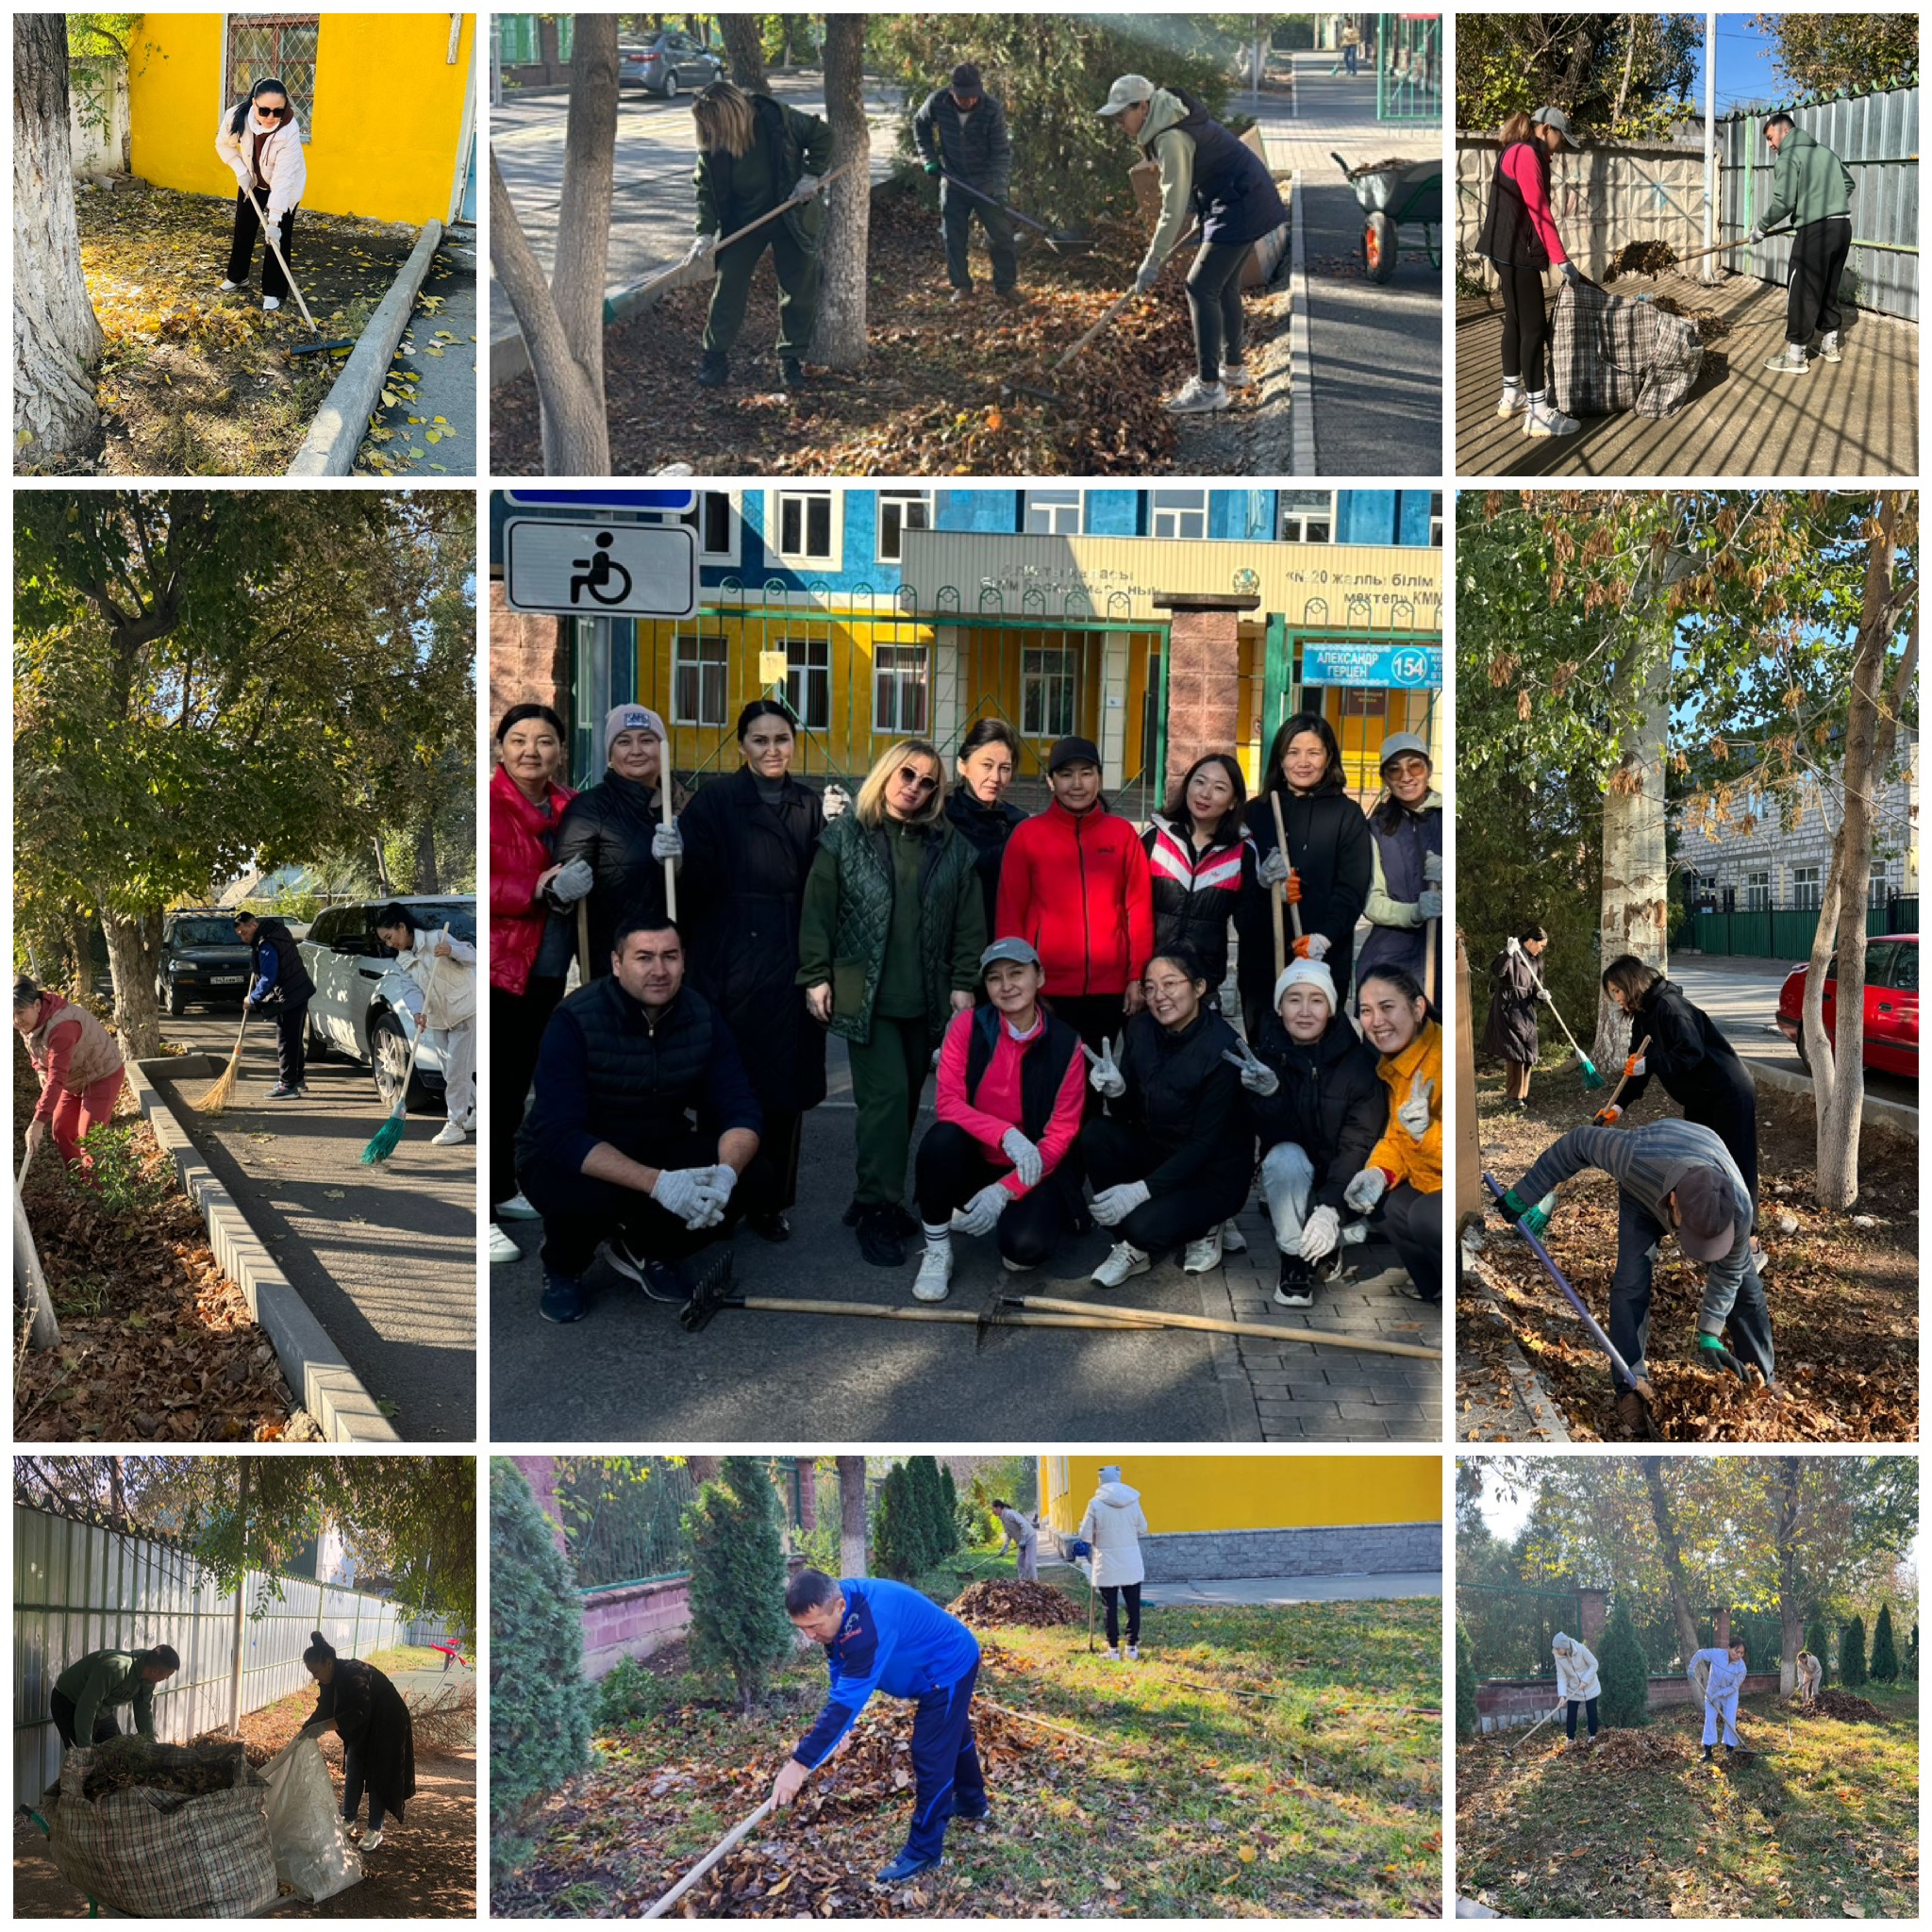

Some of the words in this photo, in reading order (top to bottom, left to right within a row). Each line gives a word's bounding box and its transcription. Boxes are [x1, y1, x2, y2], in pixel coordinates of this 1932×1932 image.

[1391, 573, 1434, 587] білім
[1317, 652, 1379, 667] АЛЕКСАНДР
[1393, 657, 1424, 676] 154
[1327, 665, 1368, 678] ГЕРЦЕН
